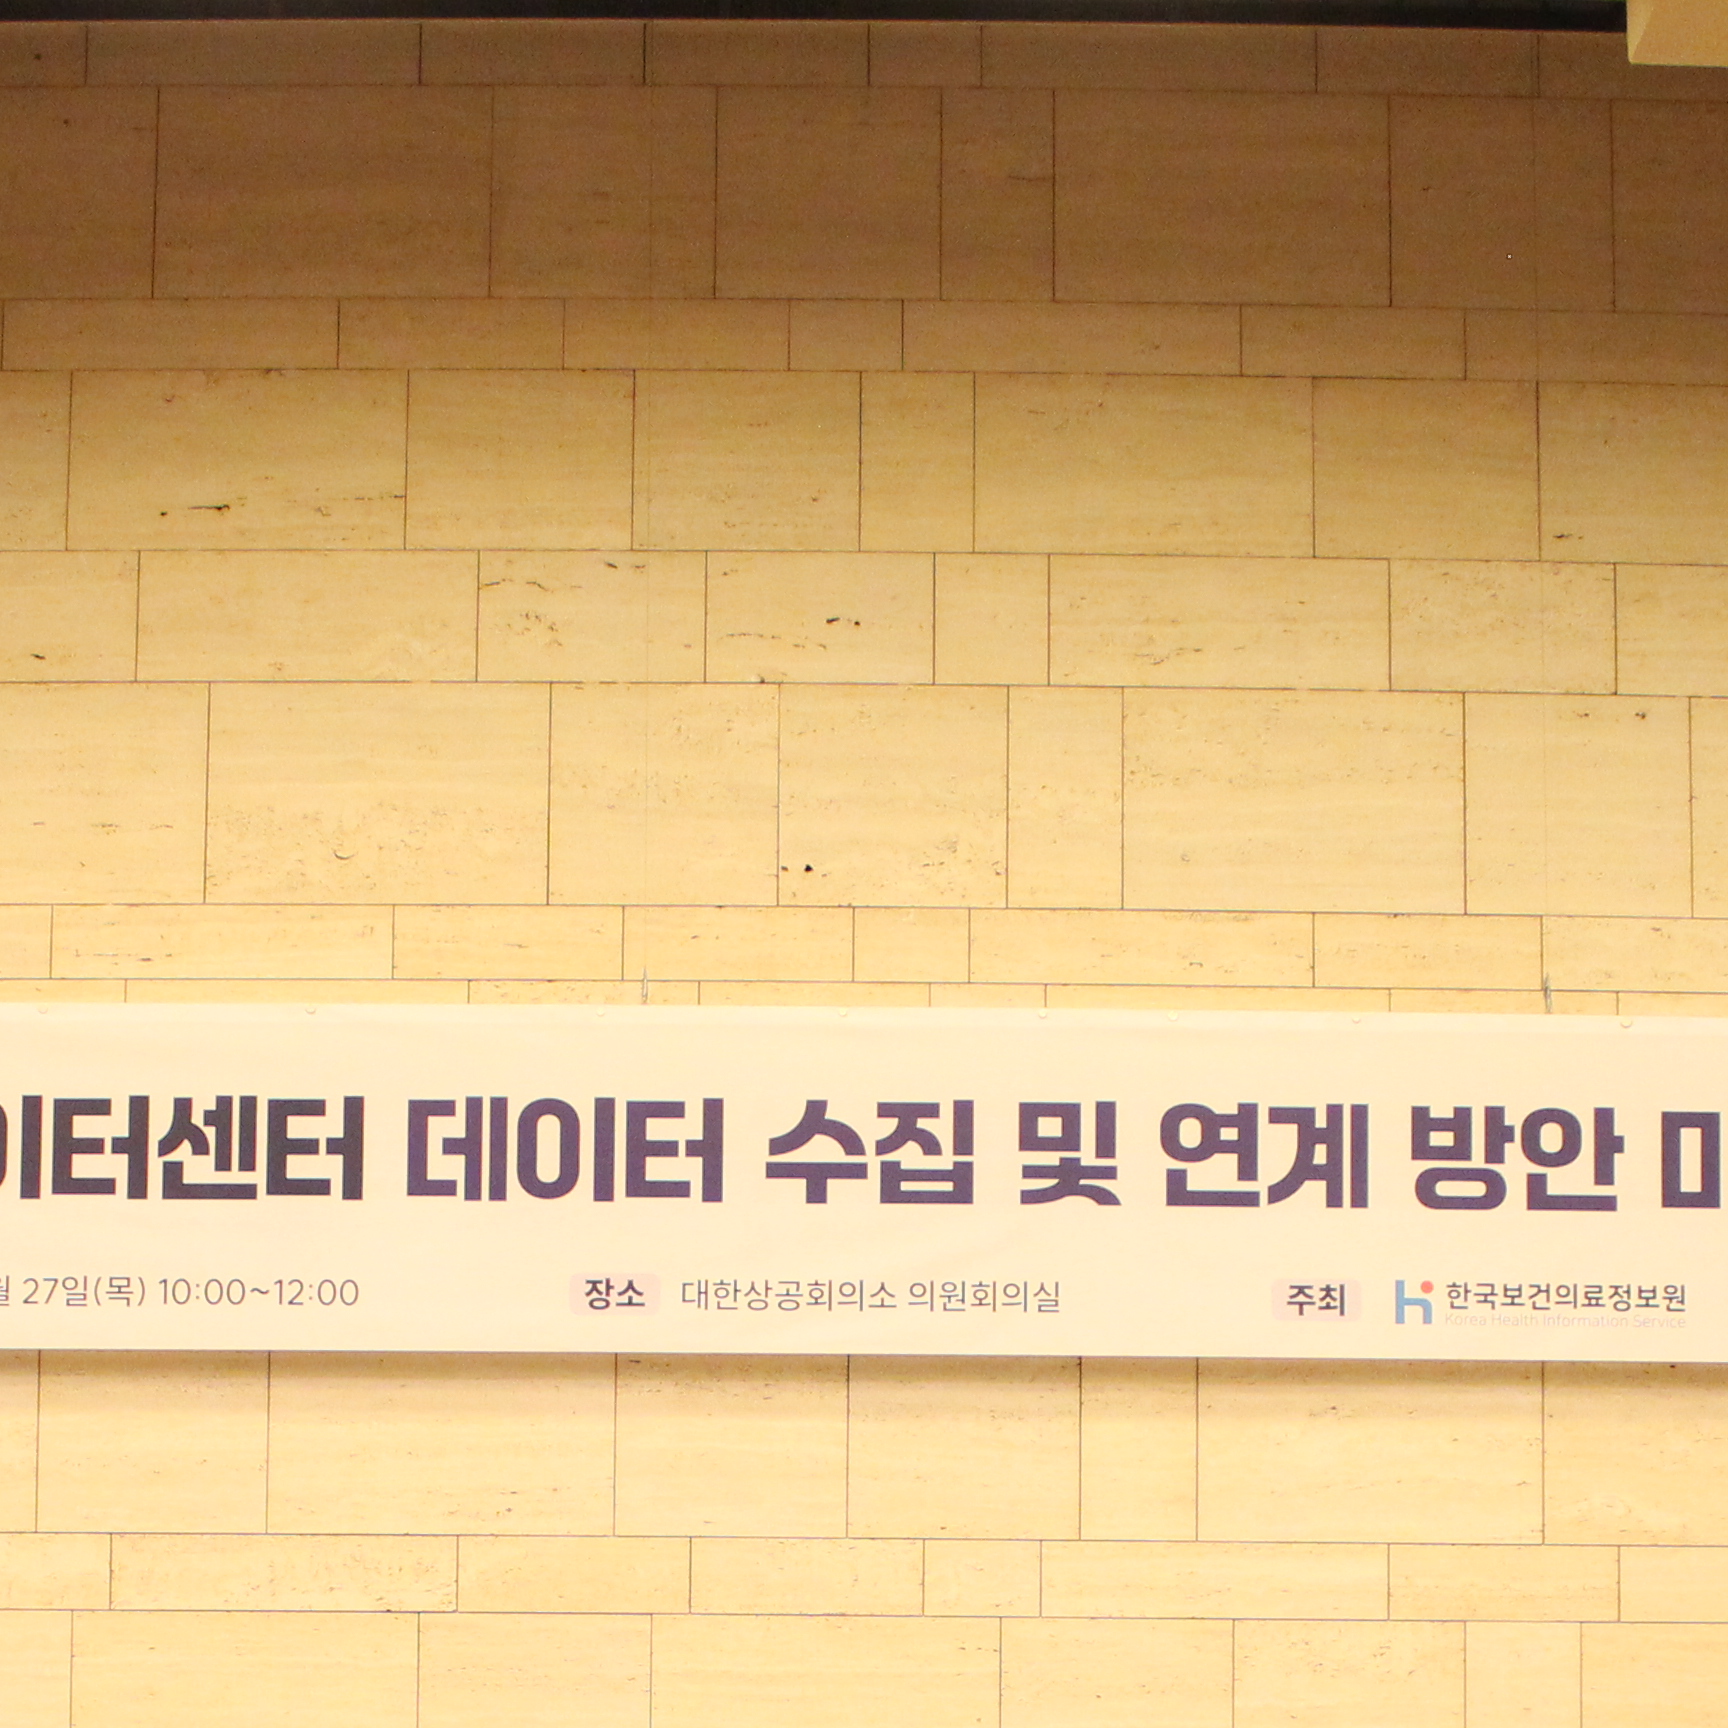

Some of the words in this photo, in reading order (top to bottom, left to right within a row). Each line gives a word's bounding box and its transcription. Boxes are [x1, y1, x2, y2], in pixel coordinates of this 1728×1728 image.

[407, 1096, 724, 1203] 데이터
[765, 1100, 974, 1205] 수집
[1018, 1101, 1121, 1206] 및
[1160, 1102, 1368, 1209] 연계
[1411, 1106, 1624, 1212] 방안
[23, 1276, 145, 1307] 27일(목)
[159, 1279, 358, 1306] 10:00~12:00
[585, 1278, 645, 1310] 장소
[682, 1279, 897, 1311] 대한상공회의소
[908, 1281, 1059, 1312] 의원회의실
[1287, 1284, 1345, 1316] 주최
[1446, 1282, 1685, 1312] 한국보건의료정보원
[1445, 1312, 1487, 1327] Korea
[1491, 1313, 1539, 1327] Health
[1543, 1313, 1629, 1328] Information
[1633, 1314, 1687, 1329] Service
